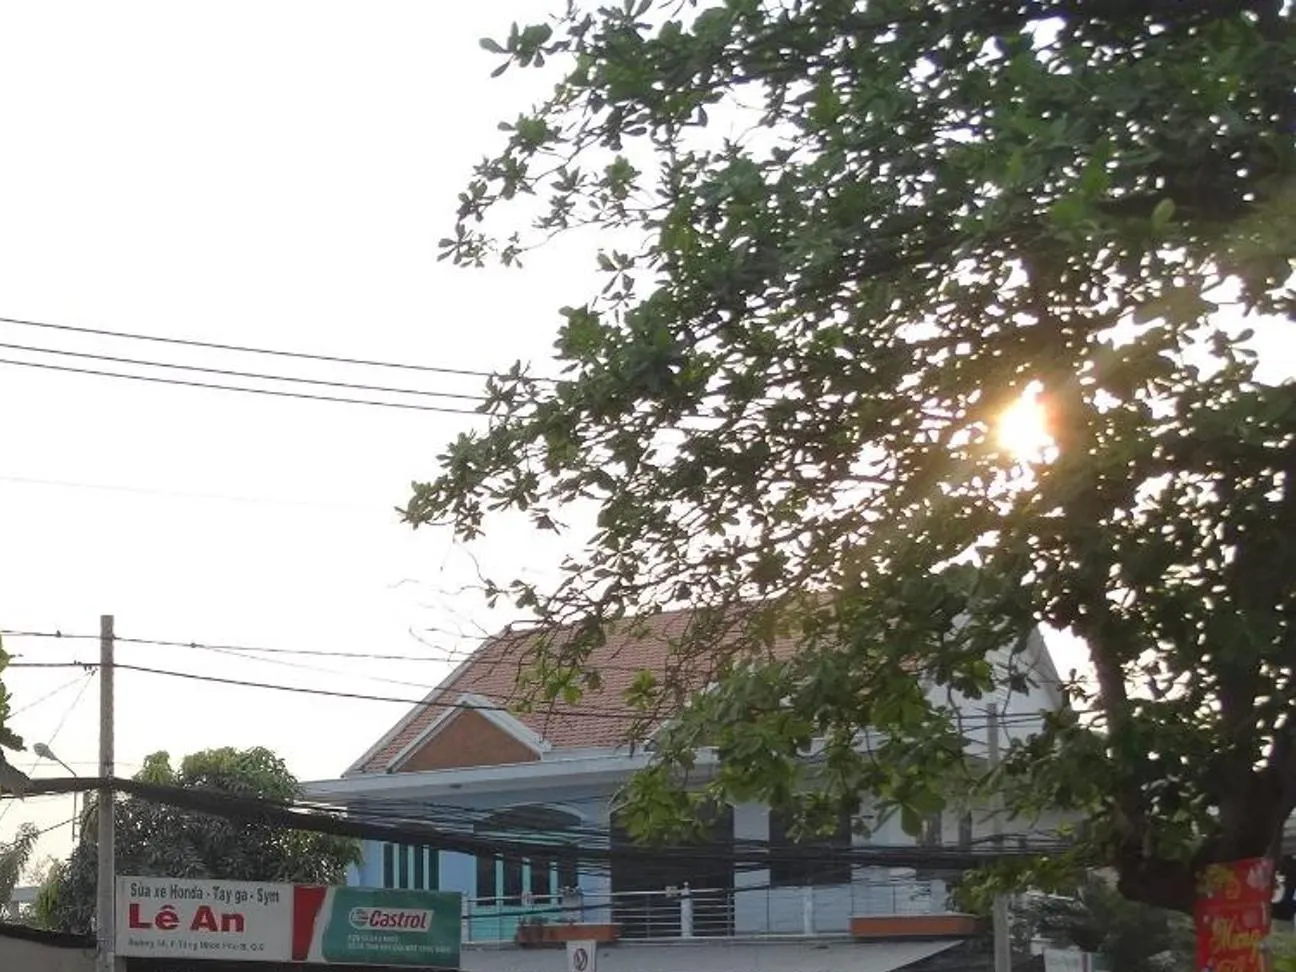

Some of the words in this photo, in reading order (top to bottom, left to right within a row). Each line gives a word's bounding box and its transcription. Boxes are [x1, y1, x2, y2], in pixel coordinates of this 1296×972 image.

[154, 886, 168, 898] xe
[170, 884, 204, 900] Honda
[212, 886, 232, 904] Tay
[235, 890, 248, 904] ga
[129, 903, 179, 930] Lê
[190, 905, 245, 932] An
[369, 910, 428, 929] Castrol
